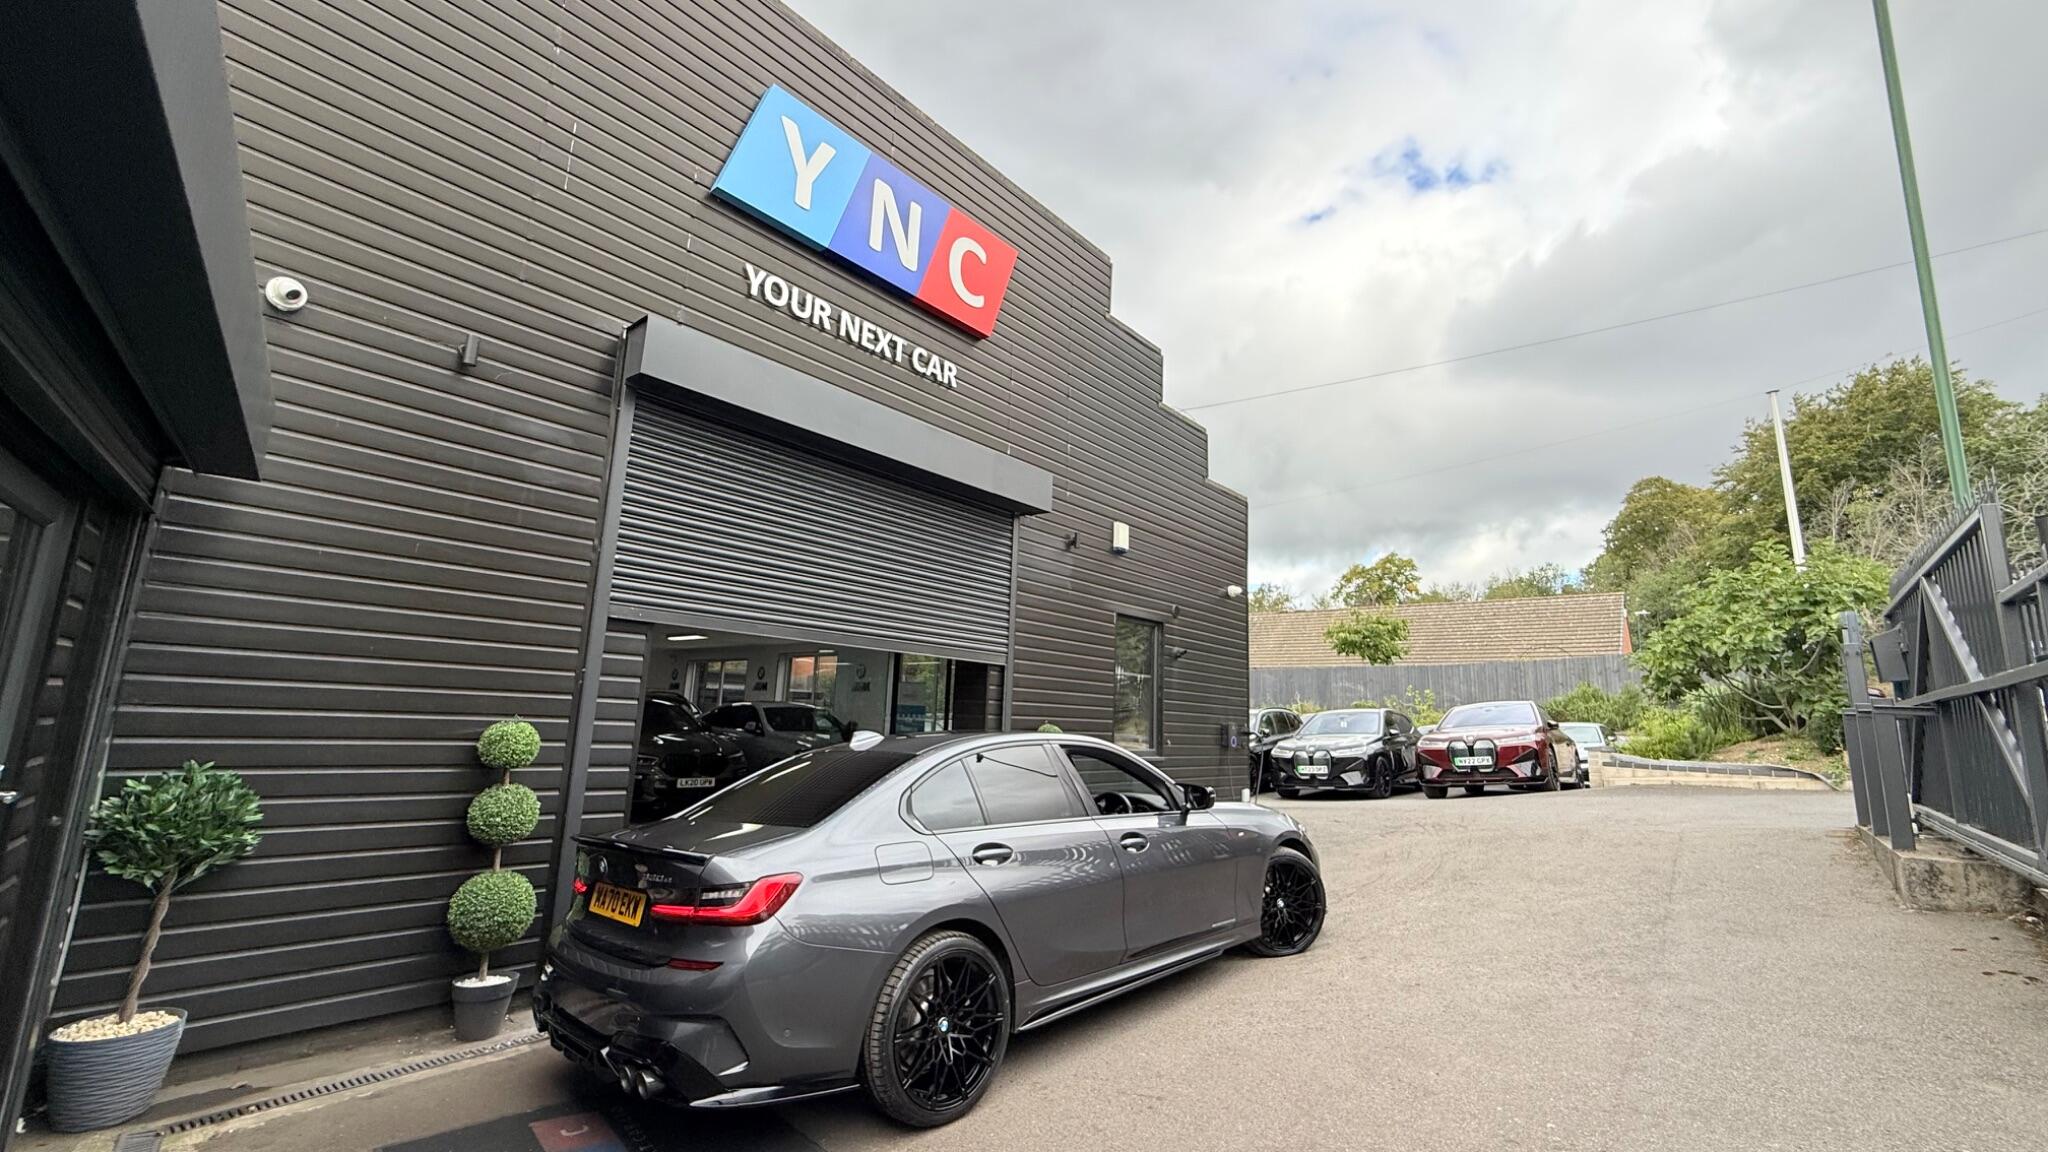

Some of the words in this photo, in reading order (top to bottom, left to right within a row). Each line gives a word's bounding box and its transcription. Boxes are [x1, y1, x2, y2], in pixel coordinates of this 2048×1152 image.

[781, 115, 987, 308] YNC
[744, 263, 832, 331] YOUR
[839, 309, 907, 363] NEXT
[911, 346, 959, 388] CAR
